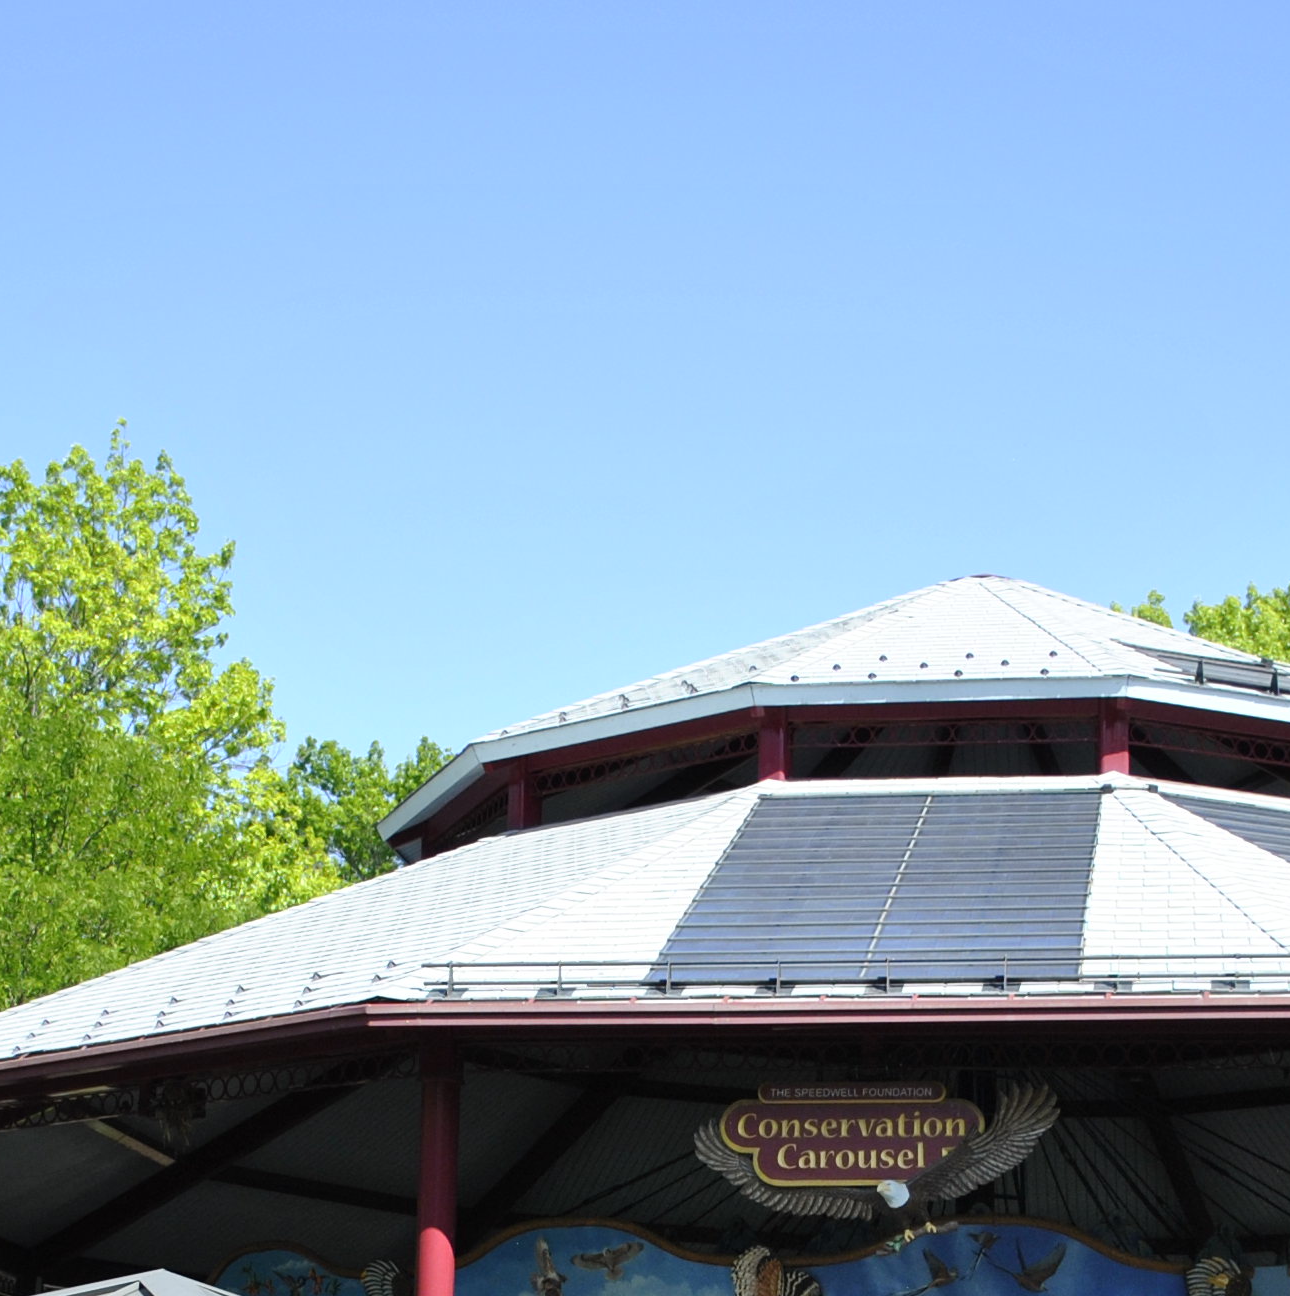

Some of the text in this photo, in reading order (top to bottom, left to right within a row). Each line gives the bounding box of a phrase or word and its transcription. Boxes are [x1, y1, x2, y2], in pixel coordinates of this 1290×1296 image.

[770, 1087, 933, 1098] THE SPEEDWELL FOUNDATION
[737, 1111, 967, 1139] Conservation
[777, 1142, 926, 1170] Carousel
